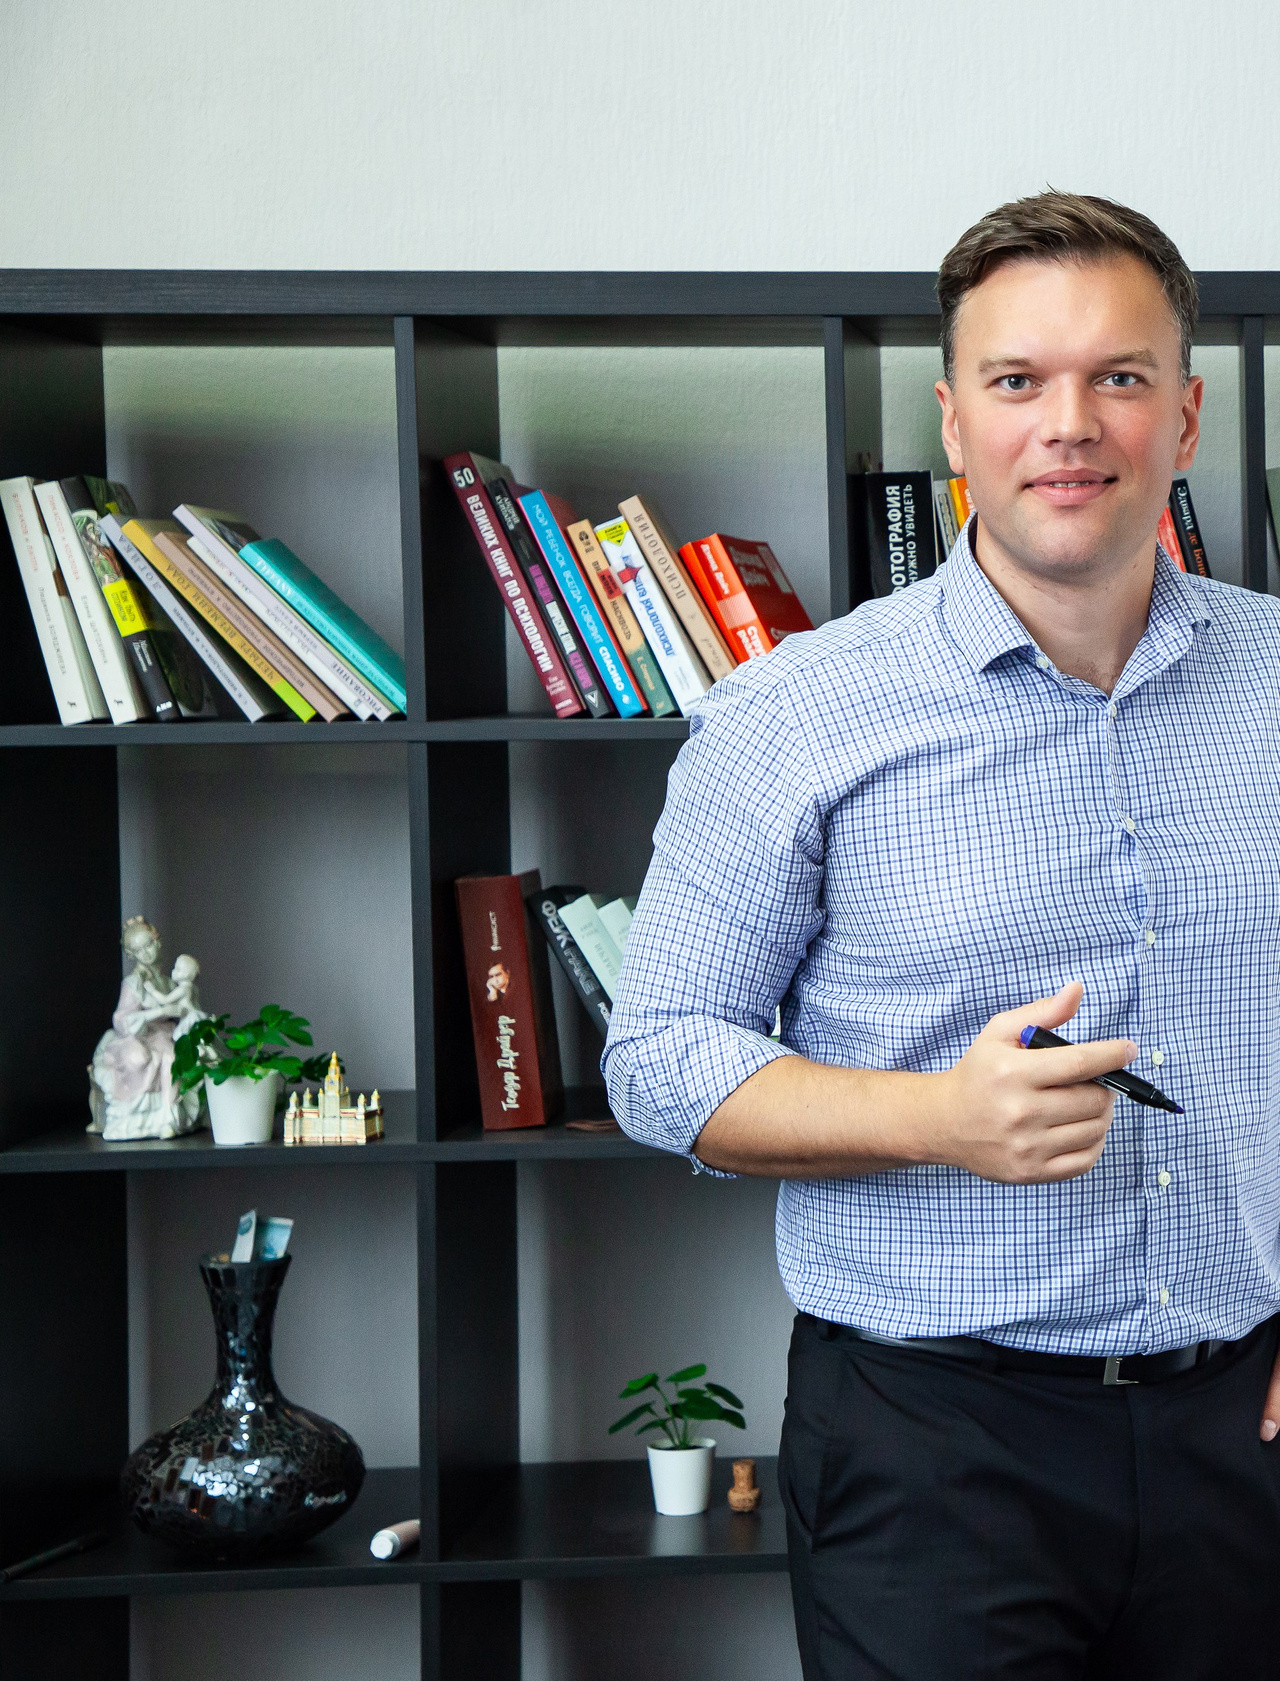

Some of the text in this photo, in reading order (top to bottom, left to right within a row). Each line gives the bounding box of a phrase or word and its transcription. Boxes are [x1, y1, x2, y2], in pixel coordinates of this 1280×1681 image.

[450, 467, 476, 487] 50
[465, 493, 501, 549] ВЕЛИКИХ
[903, 484, 916, 537] УВИДЕТЬ
[1173, 485, 1197, 531] Эдвард
[115, 532, 164, 592] ЛОГИКА
[163, 562, 192, 591] ГОДА
[490, 547, 515, 581] КНИГ
[632, 511, 688, 601] ПСИХОЛОГИЯ
[190, 589, 239, 640] ВРЕМЕНИ
[504, 579, 522, 599] ПО
[511, 596, 555, 673] ПСИХОЛОГИИ
[561, 568, 585, 604] ВСЕГДА
[597, 645, 626, 693] СПАСИБО
[236, 639, 277, 682] ЧЕТЫРЕ
